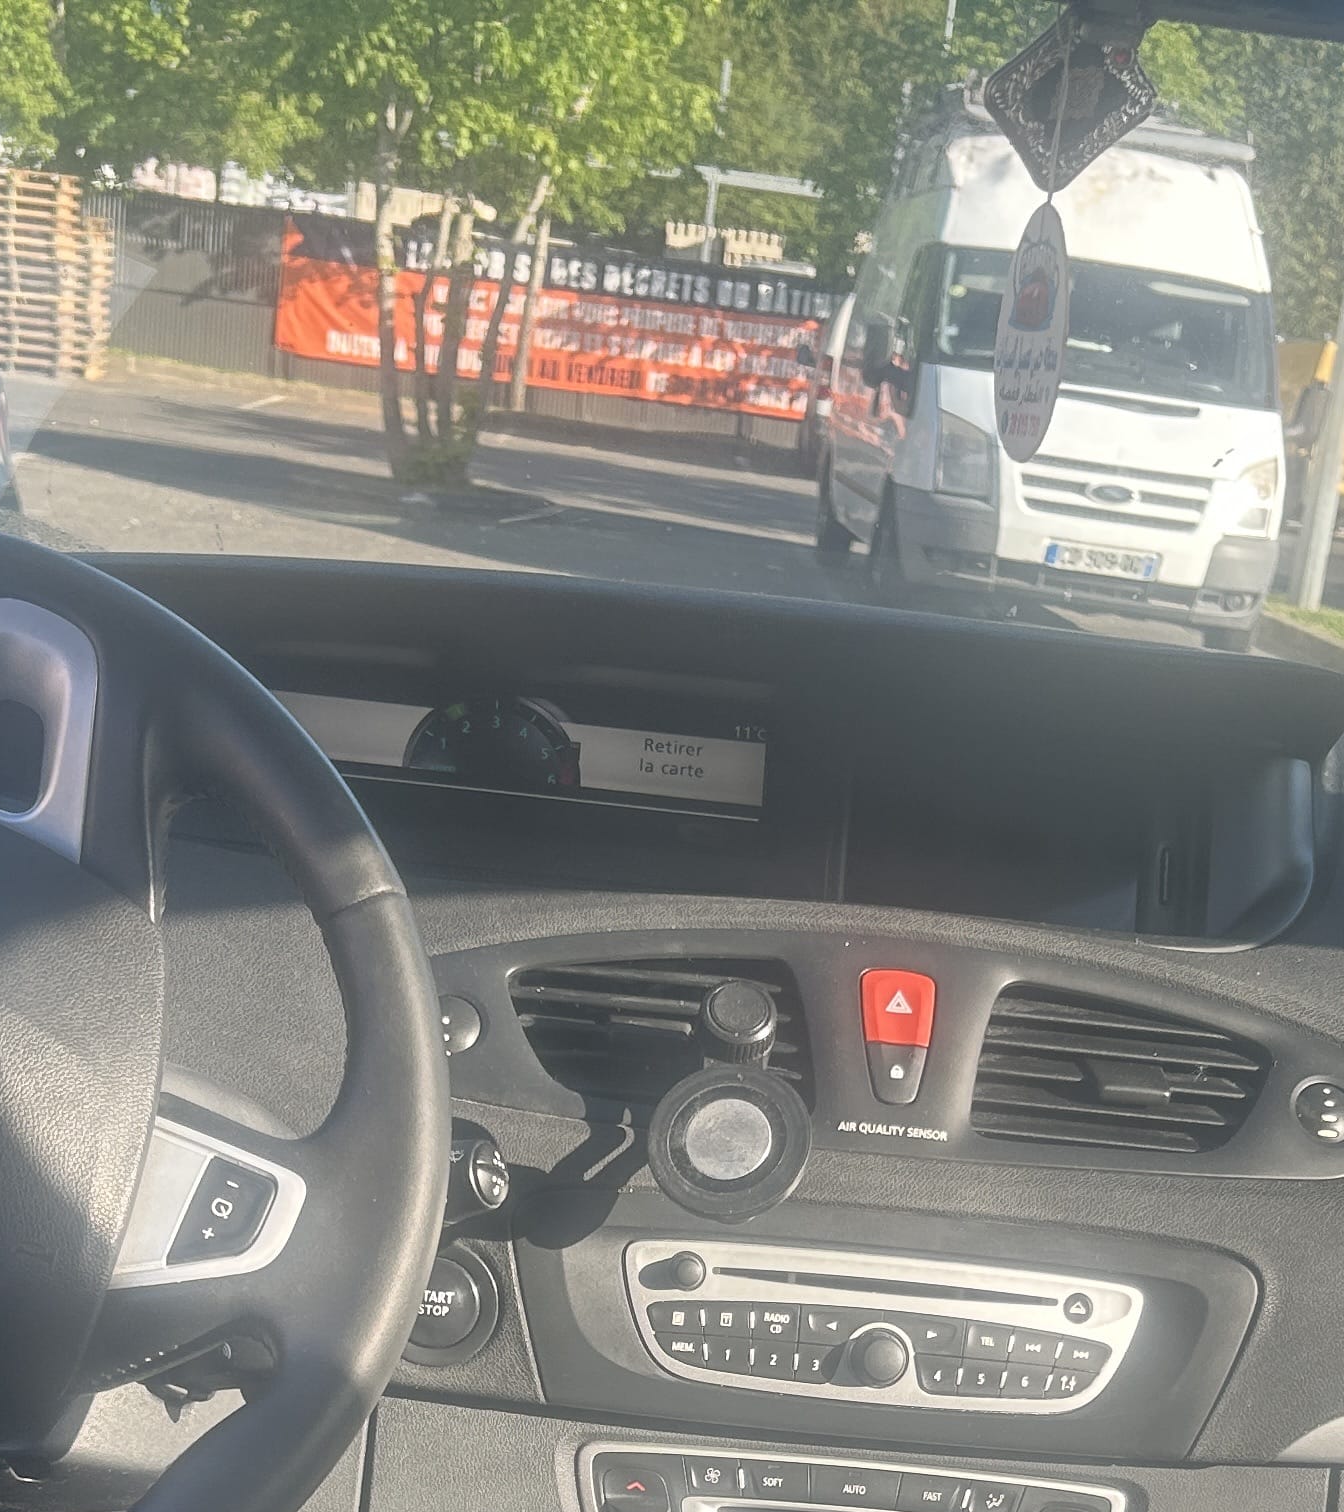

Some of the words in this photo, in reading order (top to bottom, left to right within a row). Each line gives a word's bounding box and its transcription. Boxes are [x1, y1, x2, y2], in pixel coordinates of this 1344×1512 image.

[644, 738, 703, 757] Retirer
[639, 757, 654, 773] la
[661, 763, 704, 778] carte
[838, 1121, 857, 1132] AIR
[859, 1122, 905, 1136] QUALITY
[907, 1127, 947, 1141] SENSOR
[424, 1290, 455, 1304] TART
[418, 1304, 449, 1316] STOP
[763, 1311, 790, 1324] RADIO
[769, 1324, 782, 1334] CD
[980, 1336, 995, 1347] TEL
[725, 1348, 731, 1361] 1
[769, 1354, 777, 1366] 2
[811, 1359, 820, 1371] 3
[933, 1370, 942, 1382] 4
[976, 1373, 985, 1385] 5
[1021, 1376, 1029, 1387] 6
[762, 1477, 784, 1488] SOFT
[842, 1485, 866, 1495] AUTO
[923, 1491, 943, 1501] FAST
